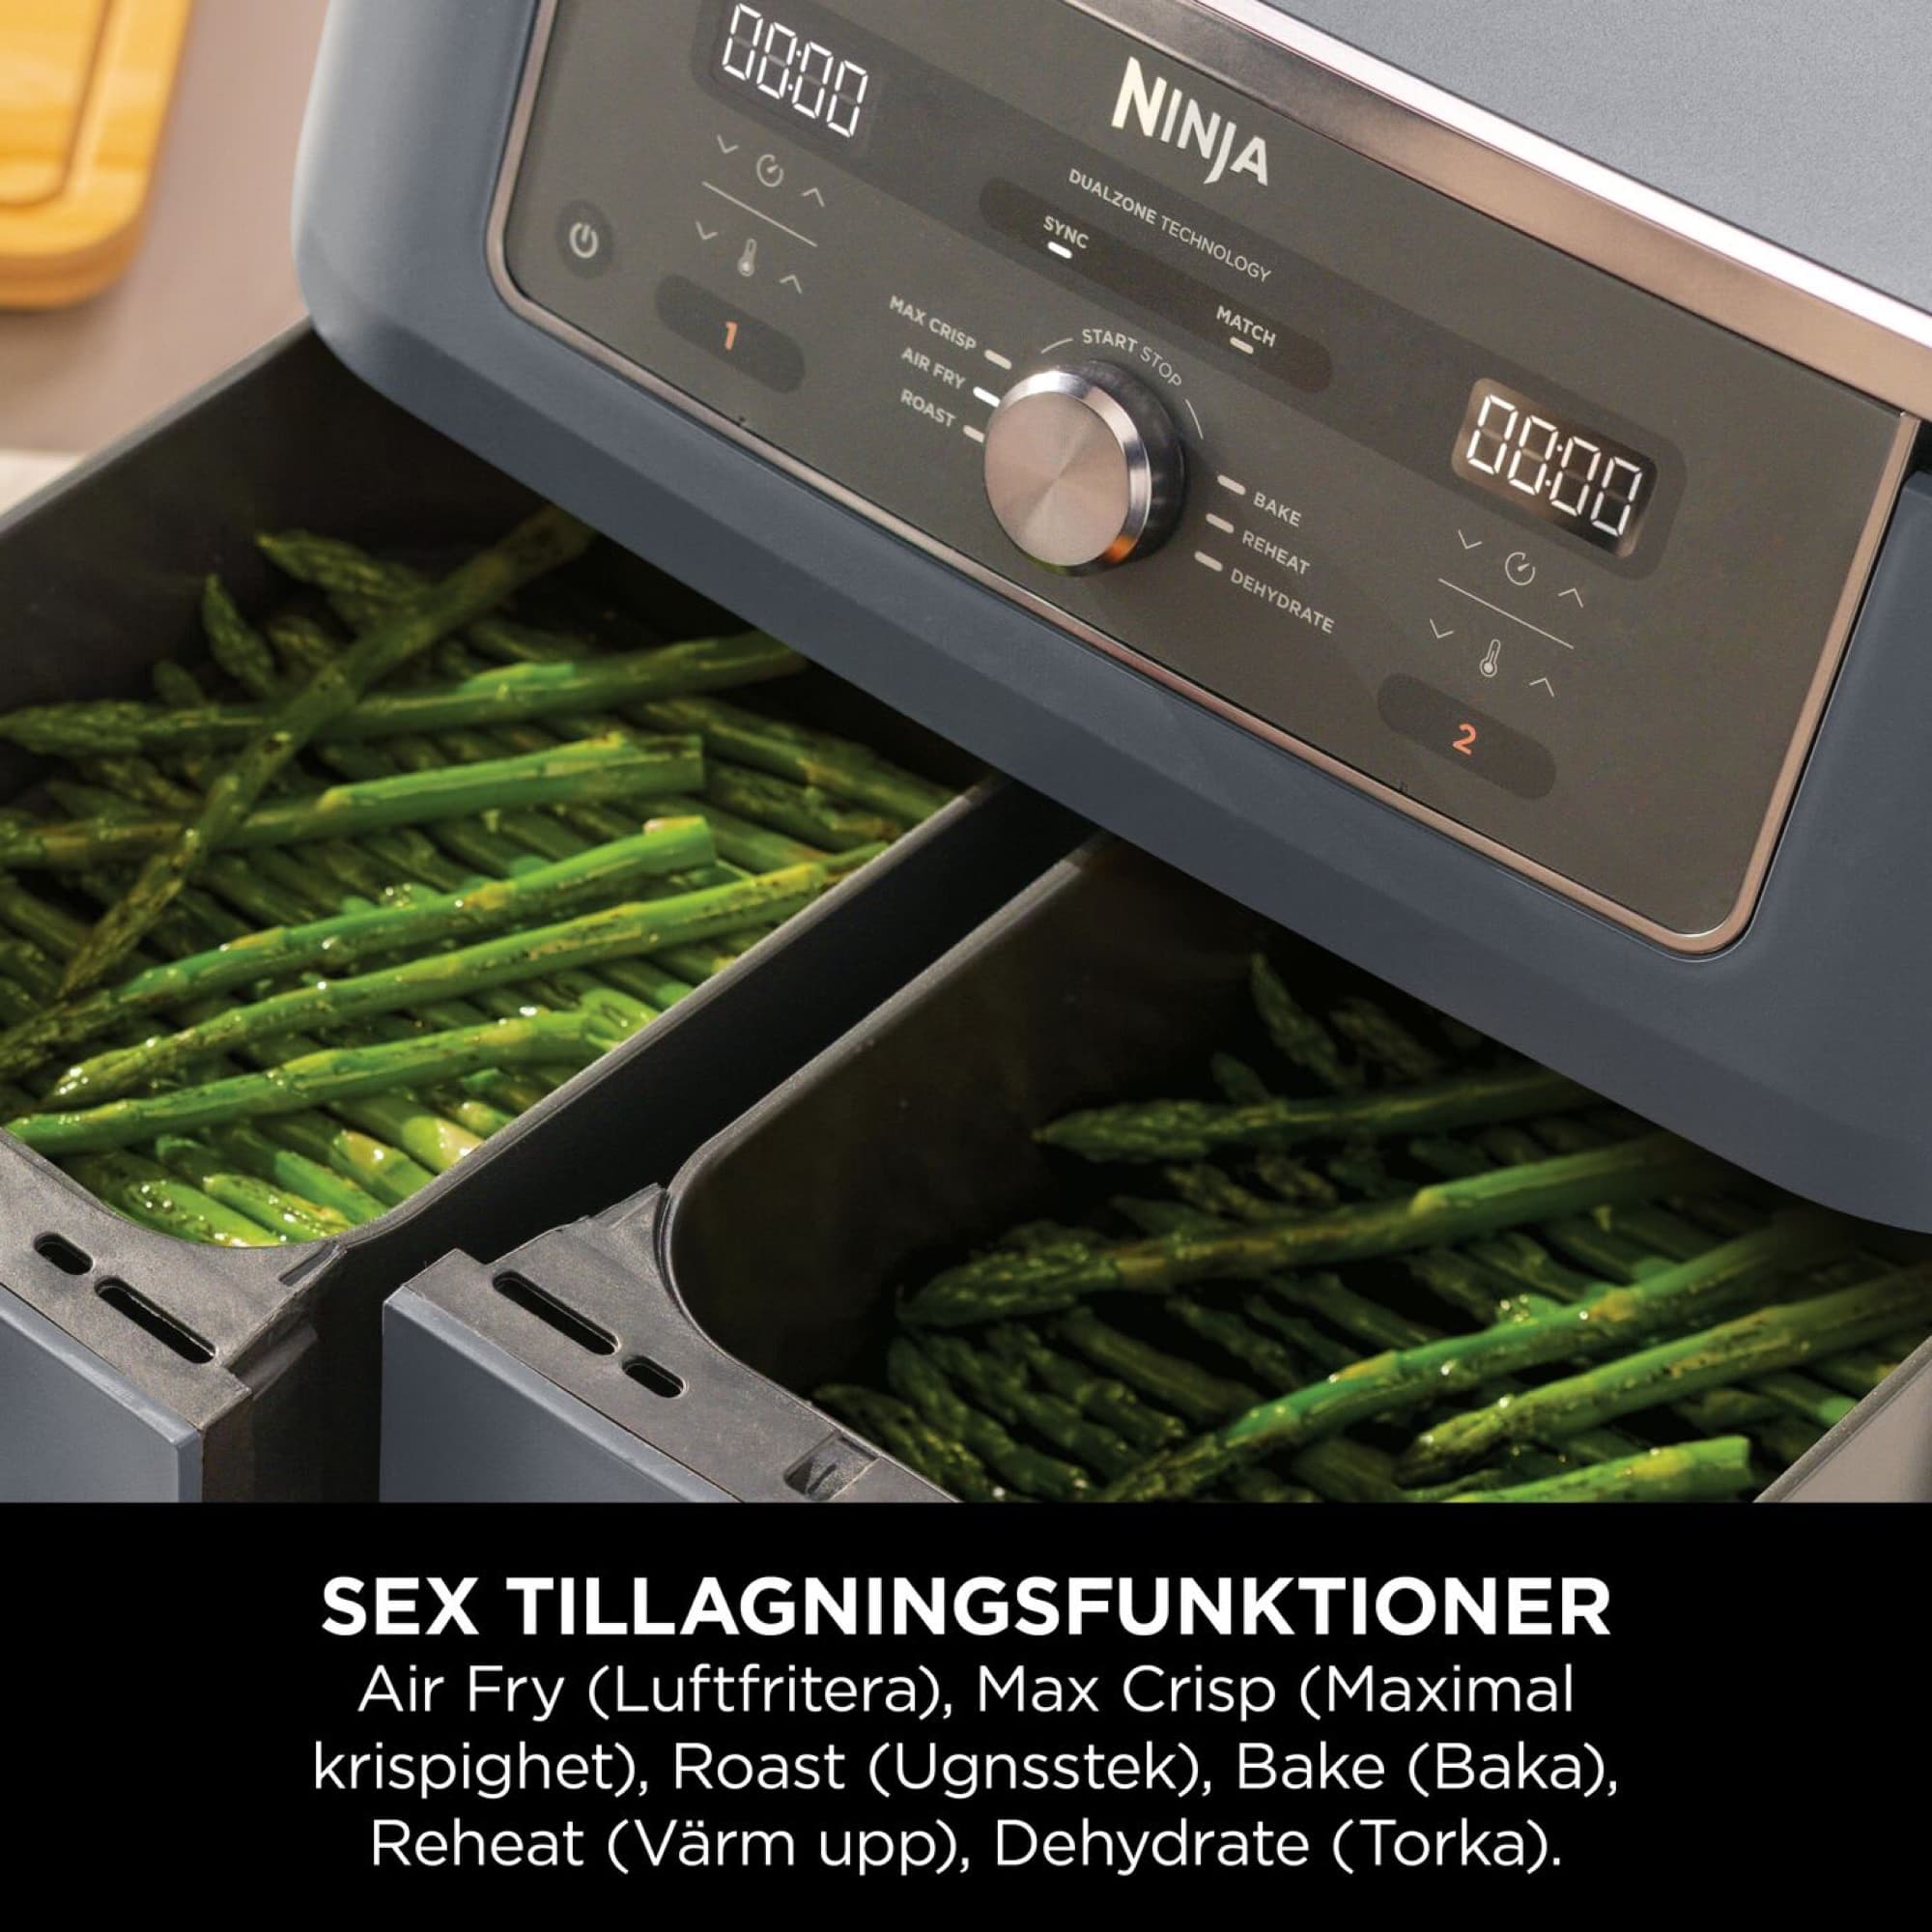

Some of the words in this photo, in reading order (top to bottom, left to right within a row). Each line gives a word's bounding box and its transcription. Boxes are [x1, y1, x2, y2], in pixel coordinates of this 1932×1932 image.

[723, 3, 868, 138] 00:00
[1111, 56, 1268, 187] NINJA
[1043, 215, 1090, 249] SYNC
[1068, 168, 1156, 226] DUALZONE
[1161, 214, 1272, 284] TECHNOLOGY
[725, 322, 738, 351] 1
[889, 295, 926, 327] MAX
[929, 317, 978, 352] CRISP
[1215, 305, 1277, 348] MATCH
[901, 347, 930, 373] AIR
[932, 361, 967, 390] FRY
[1082, 328, 1138, 355] START
[1140, 347, 1182, 387] STOP
[900, 389, 956, 428] ROAST
[1466, 393, 1642, 537] 00:00
[1253, 492, 1302, 527] BAKE
[1241, 530, 1310, 577] REHEAT
[1230, 568, 1335, 634] DEHYDRATE
[1452, 723, 1477, 755] 2
